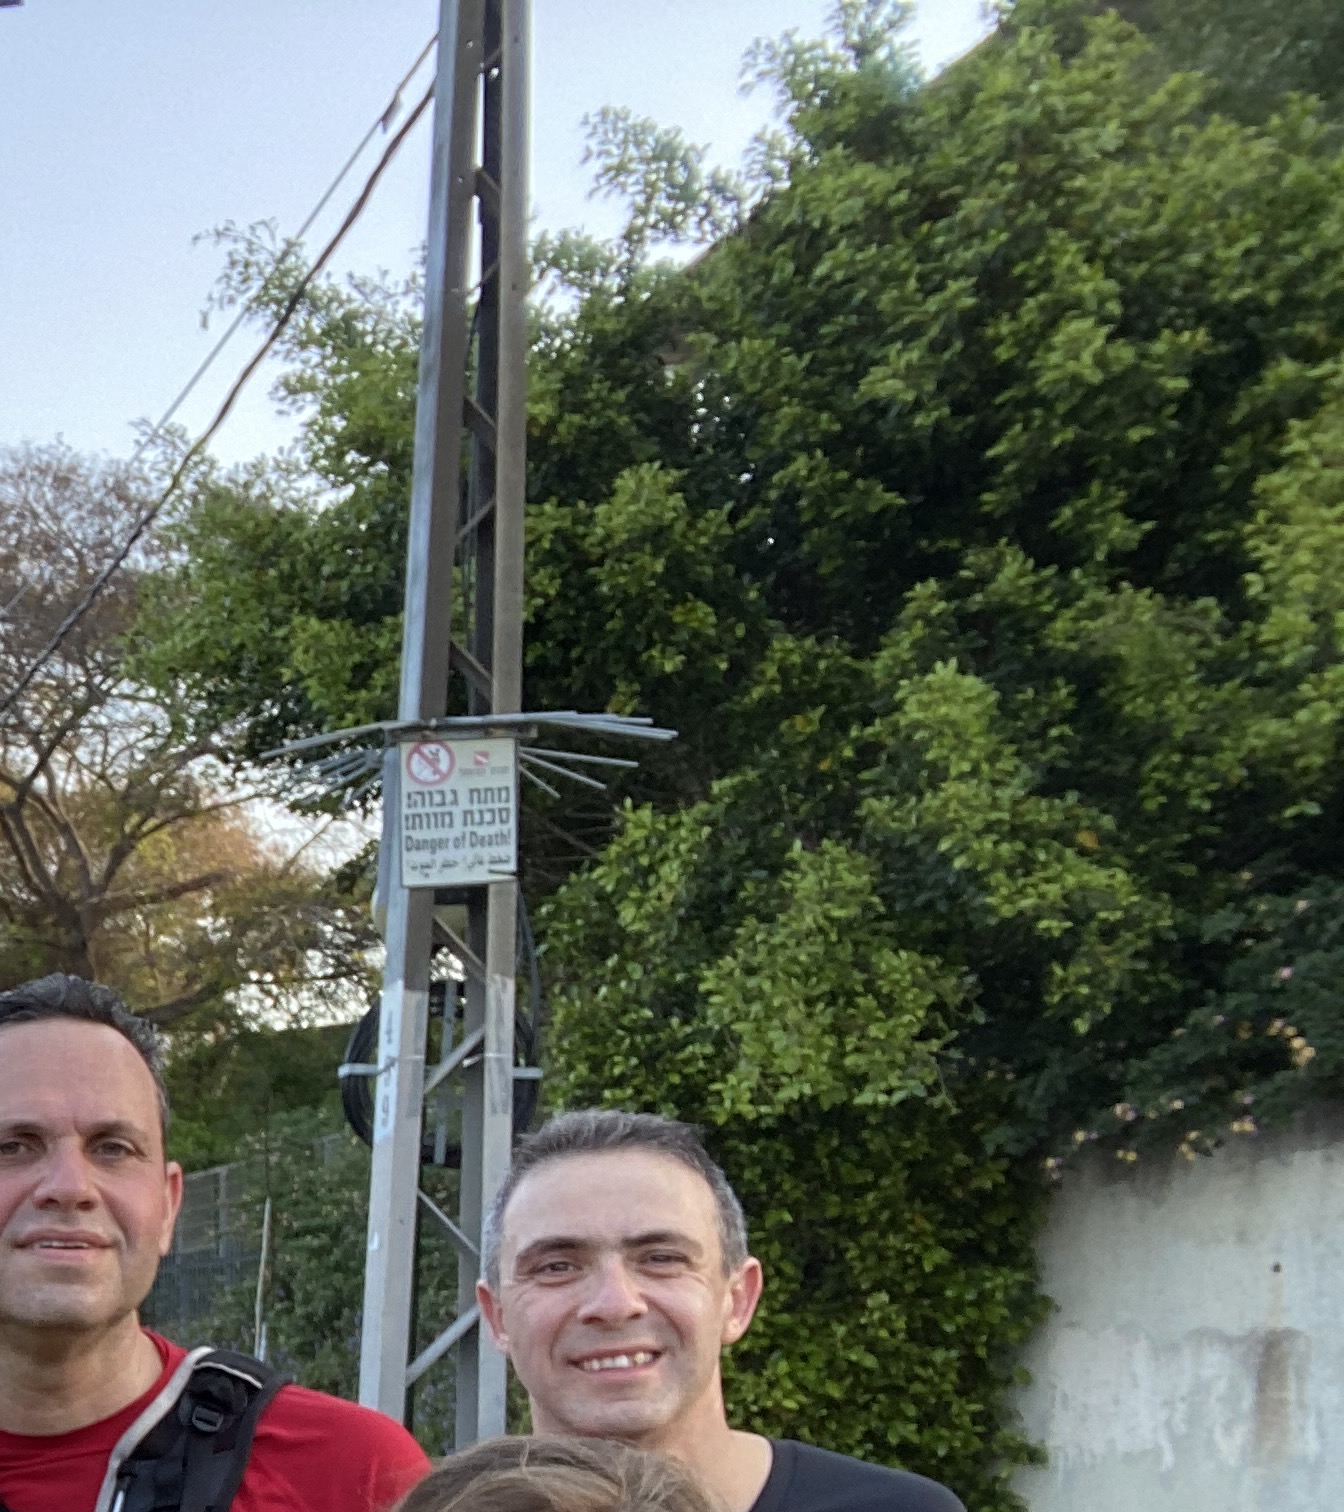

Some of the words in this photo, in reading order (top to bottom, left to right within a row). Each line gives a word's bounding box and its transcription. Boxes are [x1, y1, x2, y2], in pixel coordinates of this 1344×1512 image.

[469, 786, 511, 805] מתח
[462, 807, 511, 827] סכנת
[405, 835, 450, 855] Danger
[453, 831, 466, 849] of
[469, 828, 511, 849] Death!
